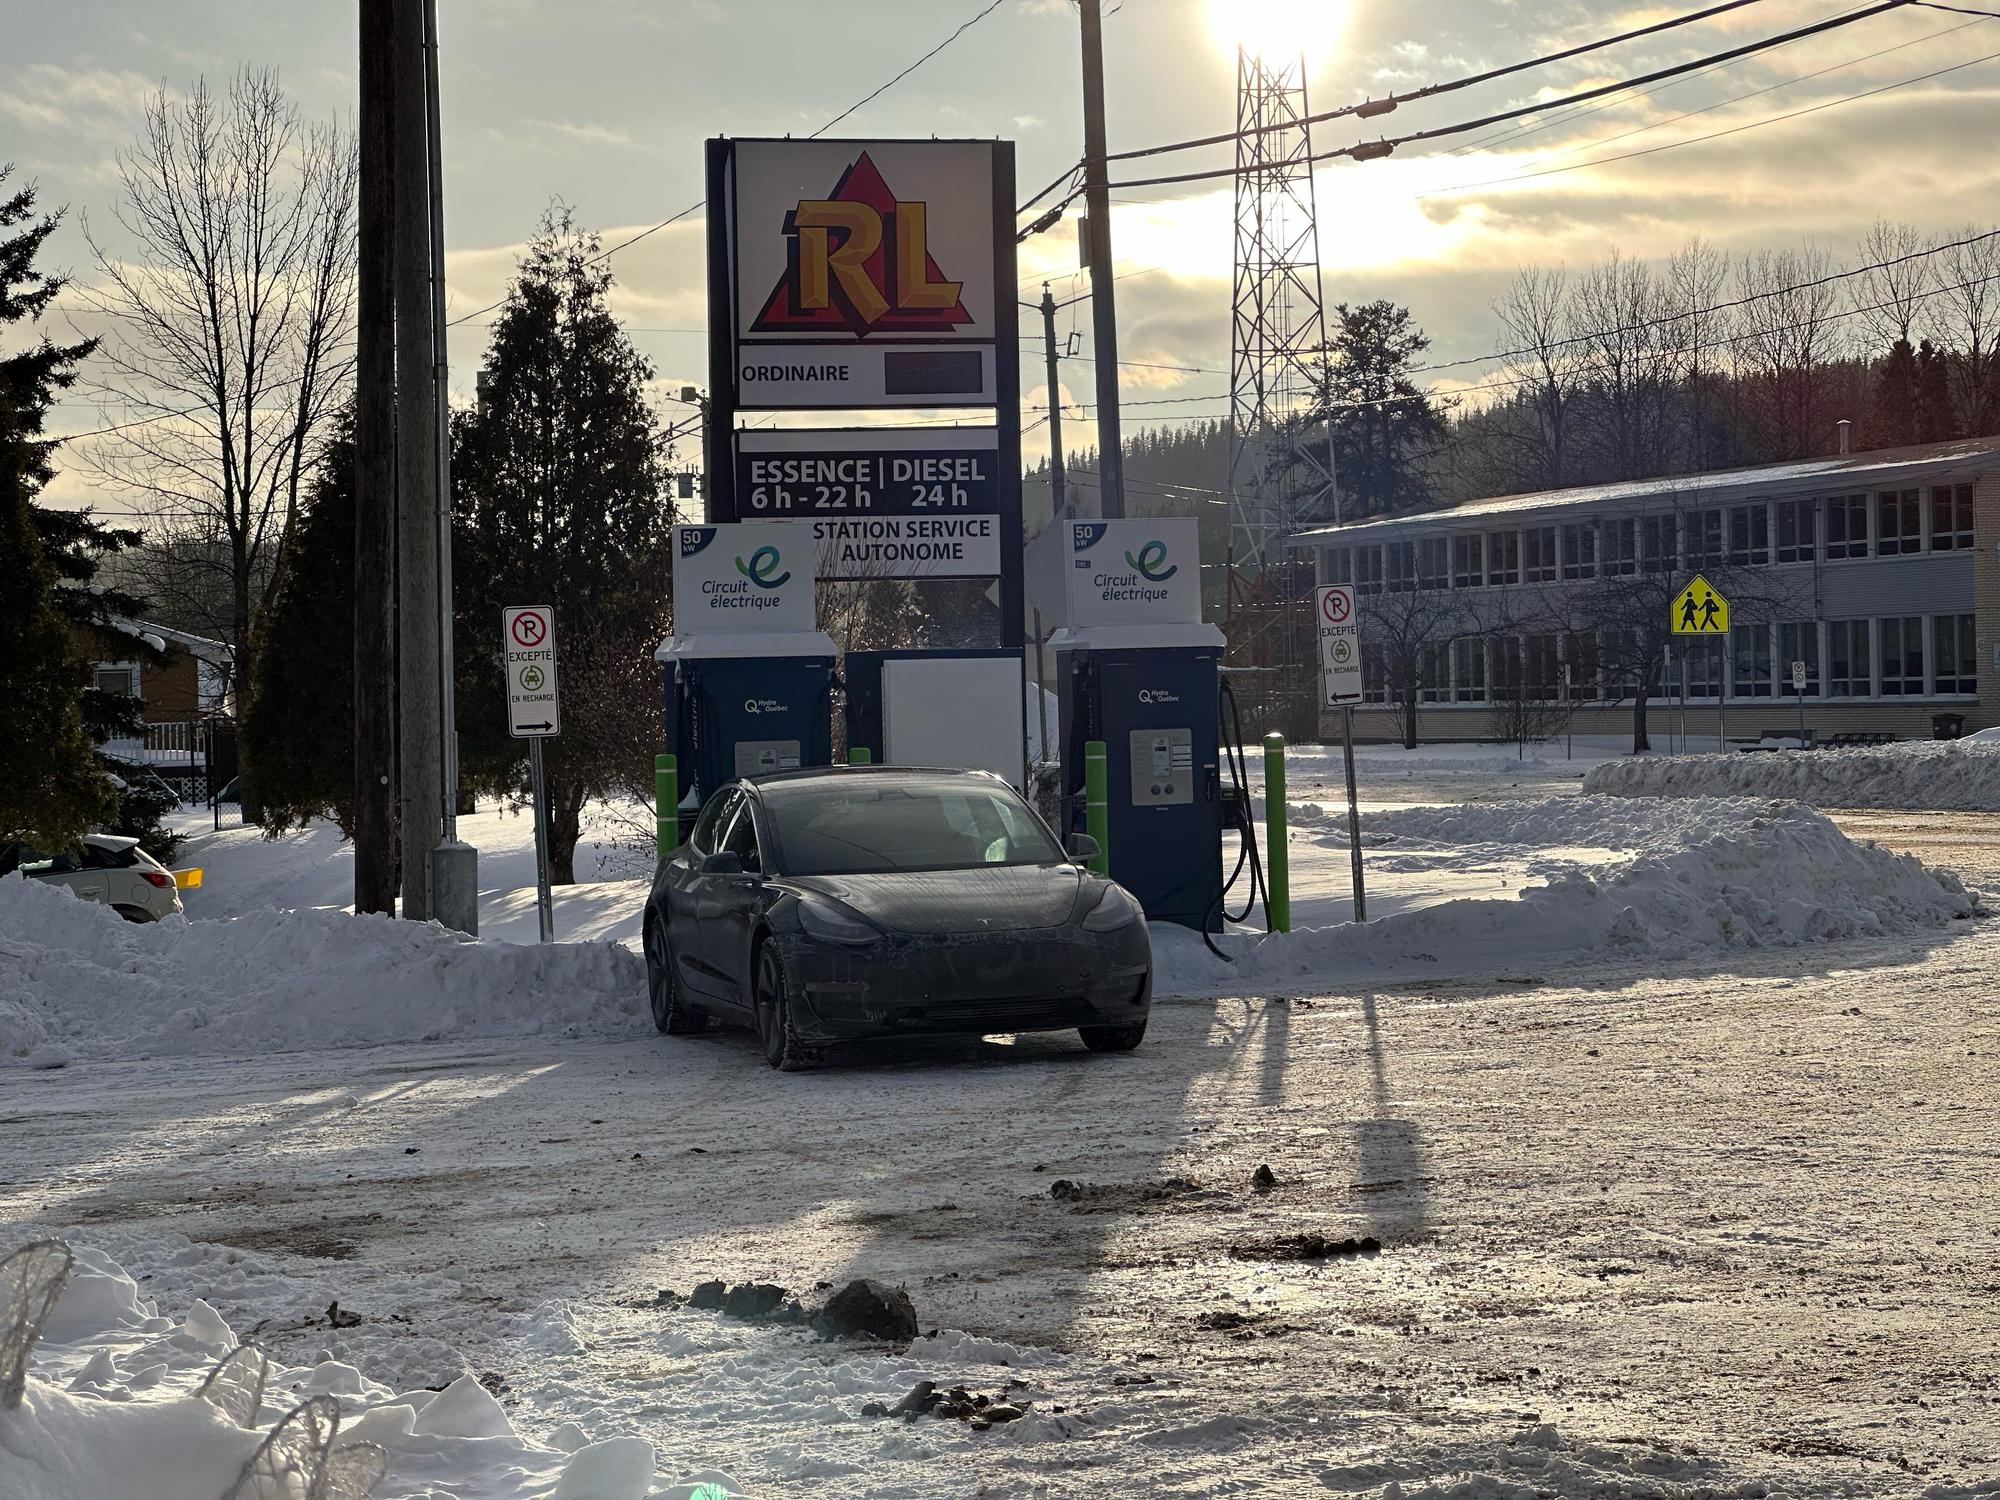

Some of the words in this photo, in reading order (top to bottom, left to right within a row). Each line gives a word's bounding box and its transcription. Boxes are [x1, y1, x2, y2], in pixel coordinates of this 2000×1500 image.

[793, 199, 964, 325] RL
[741, 365, 849, 381] ORDINAIRE
[751, 459, 871, 483] ESSENCE
[893, 458, 985, 482] DIESEL
[813, 521, 901, 540] STATION
[906, 520, 991, 538] SERVICE
[1075, 526, 1093, 539] 50
[683, 531, 701, 544] 50
[683, 544, 696, 552] kW
[841, 542, 964, 561] AUTONOME
[702, 580, 748, 594] Circuit
[1094, 573, 1138, 587] Circuit
[710, 594, 780, 610] électrique
[1102, 587, 1168, 603] électrique
[1321, 625, 1356, 636] EXCEPTÉ
[509, 649, 553, 662] EXCEPTÉ
[512, 695, 521, 703] EN
[523, 694, 554, 702] RECHARGE
[758, 699, 777, 708] Hydro
